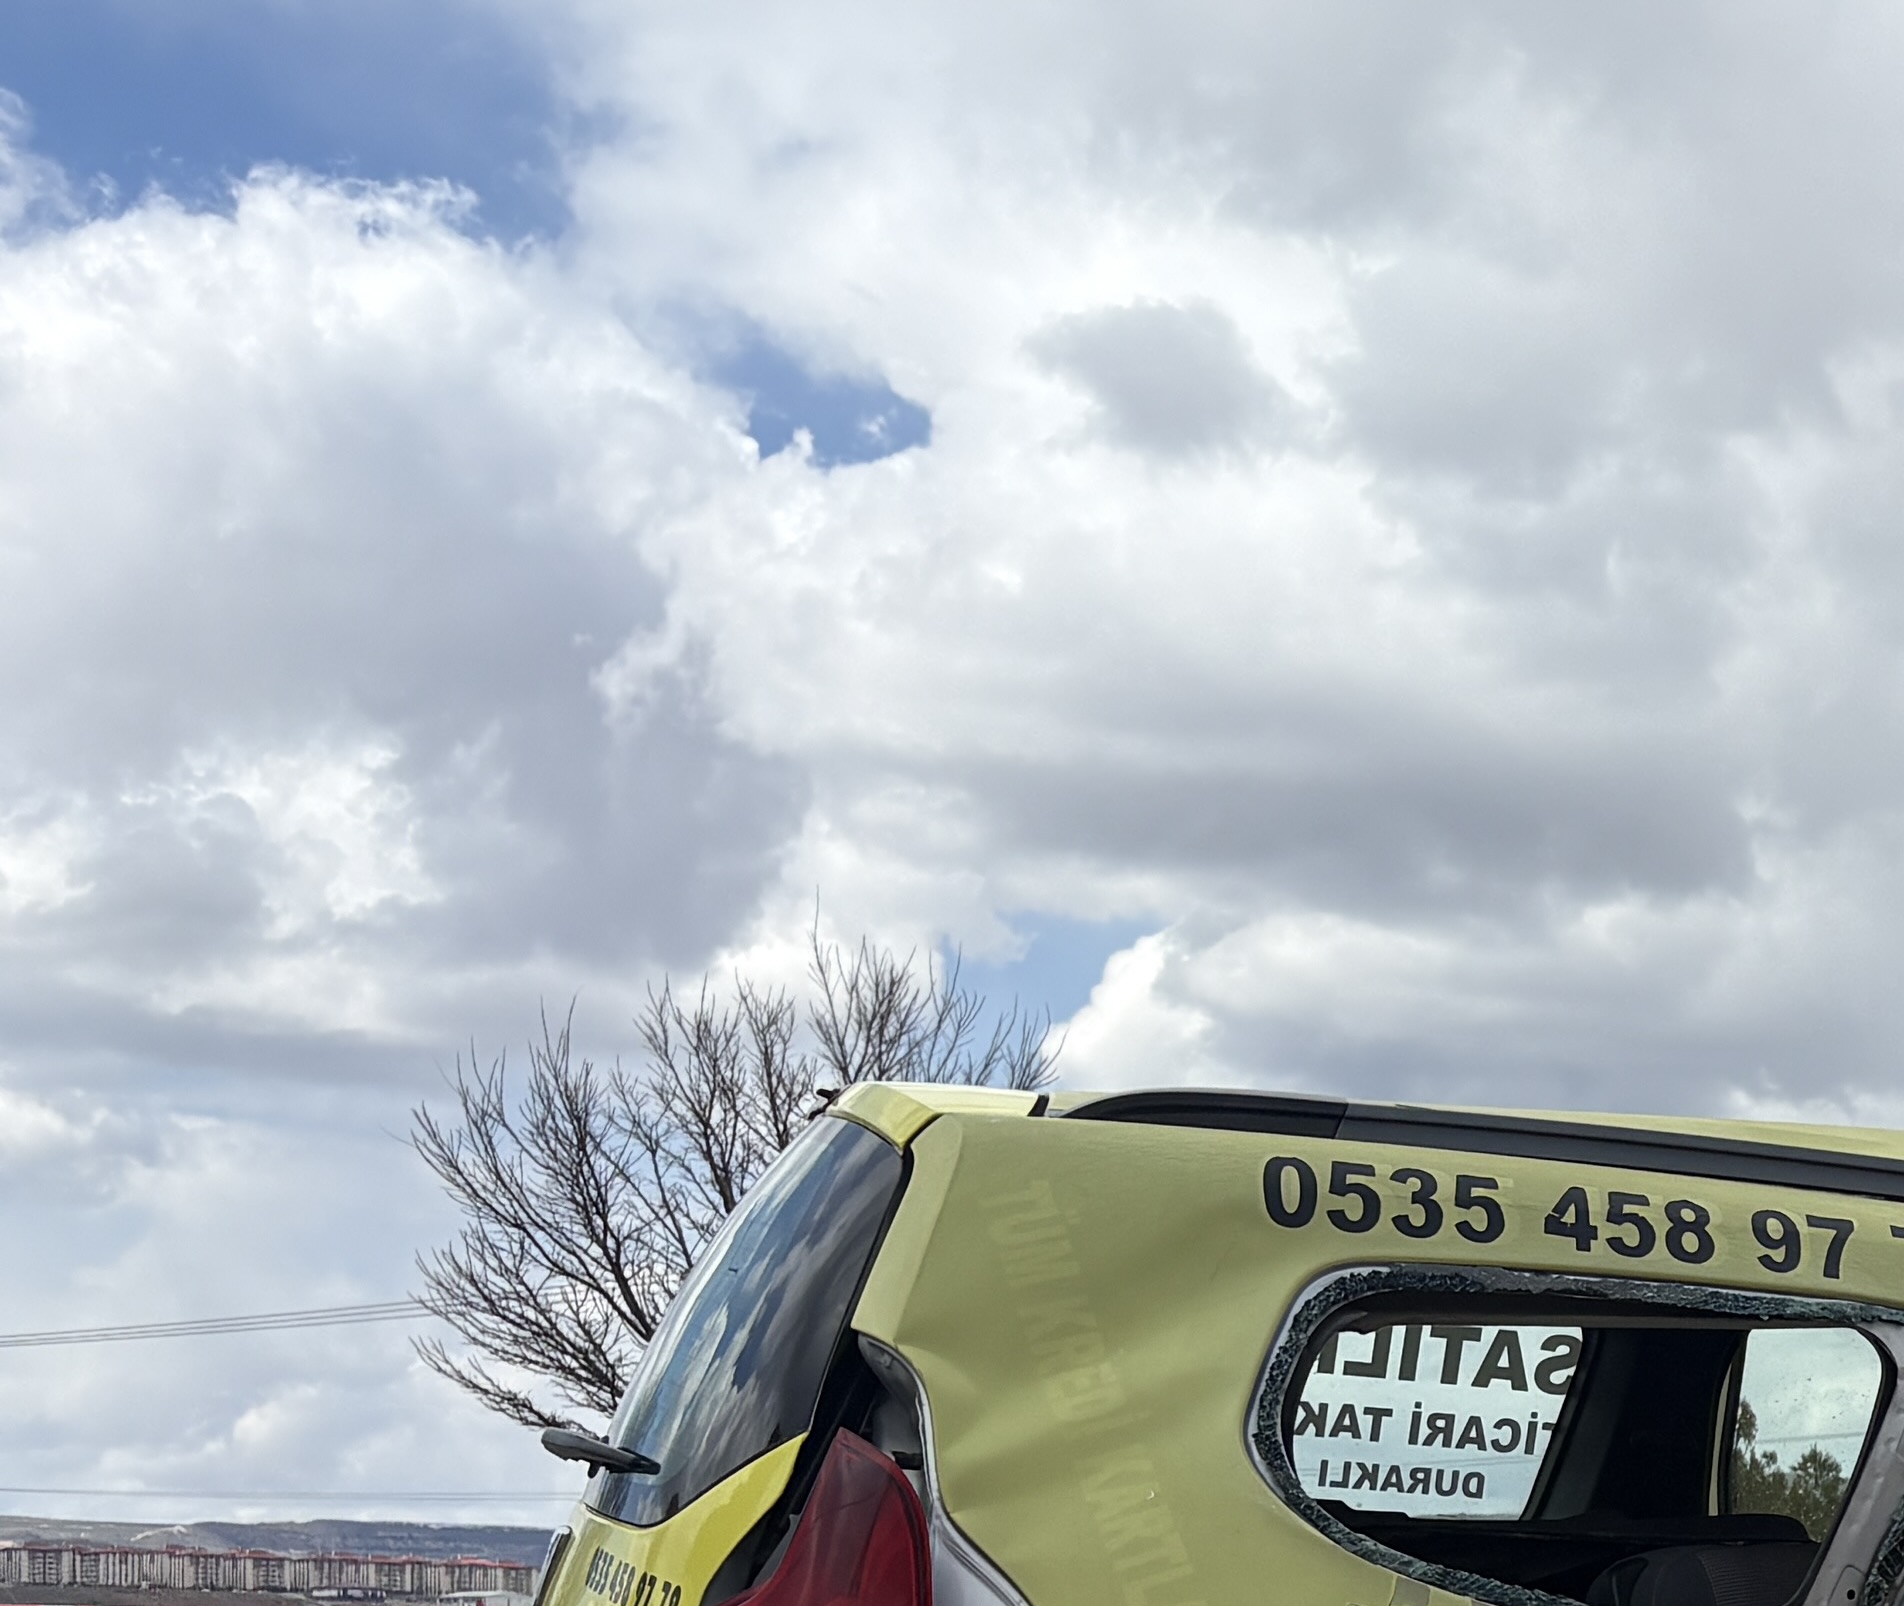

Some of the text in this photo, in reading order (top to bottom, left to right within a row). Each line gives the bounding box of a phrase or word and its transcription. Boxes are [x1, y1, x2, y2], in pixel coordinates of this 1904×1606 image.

[1262, 1156, 1506, 1244] 0535
[1543, 1186, 1715, 1265] 458
[1751, 1209, 1855, 1280] 97
